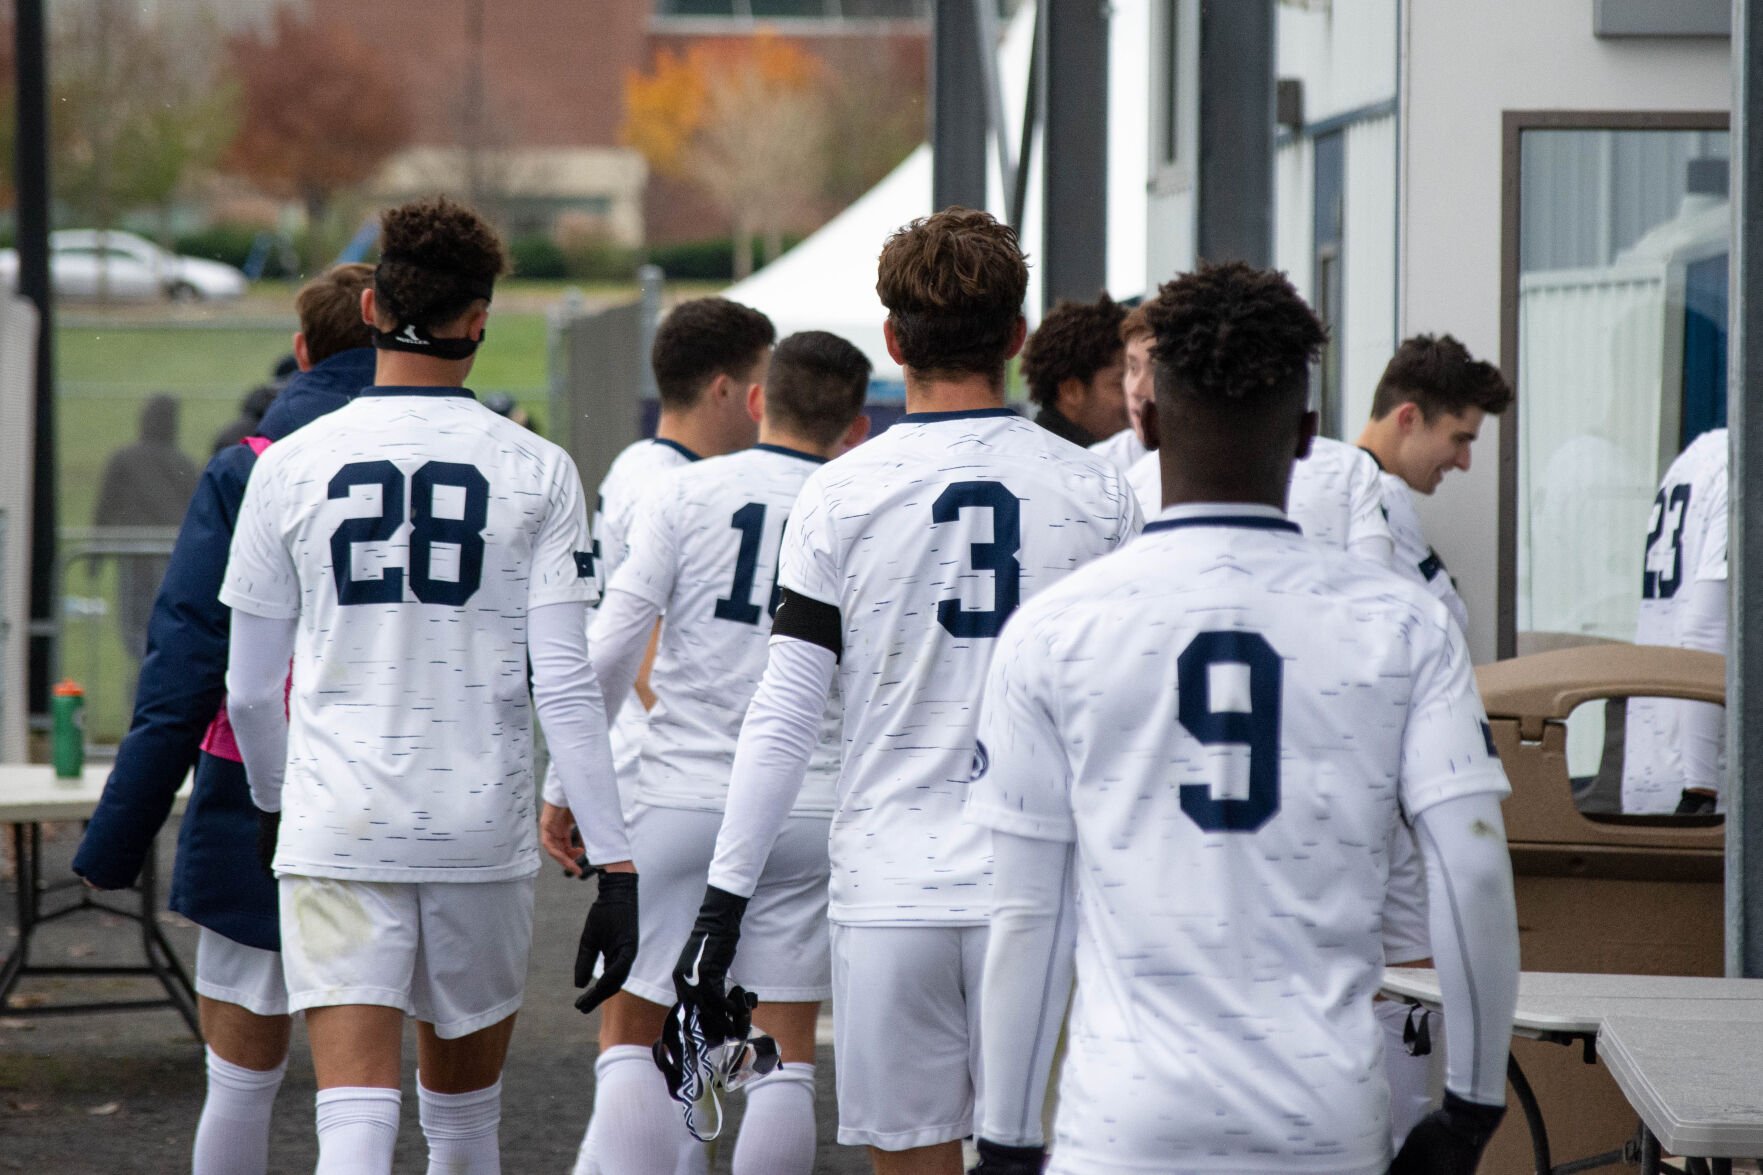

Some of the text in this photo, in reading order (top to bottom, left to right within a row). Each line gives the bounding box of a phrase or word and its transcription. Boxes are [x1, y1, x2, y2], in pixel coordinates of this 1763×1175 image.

[327, 460, 490, 606] 28
[714, 502, 789, 626] 1
[932, 481, 1020, 638] 3
[1642, 483, 1692, 599] 23
[1177, 630, 1284, 834] 9
